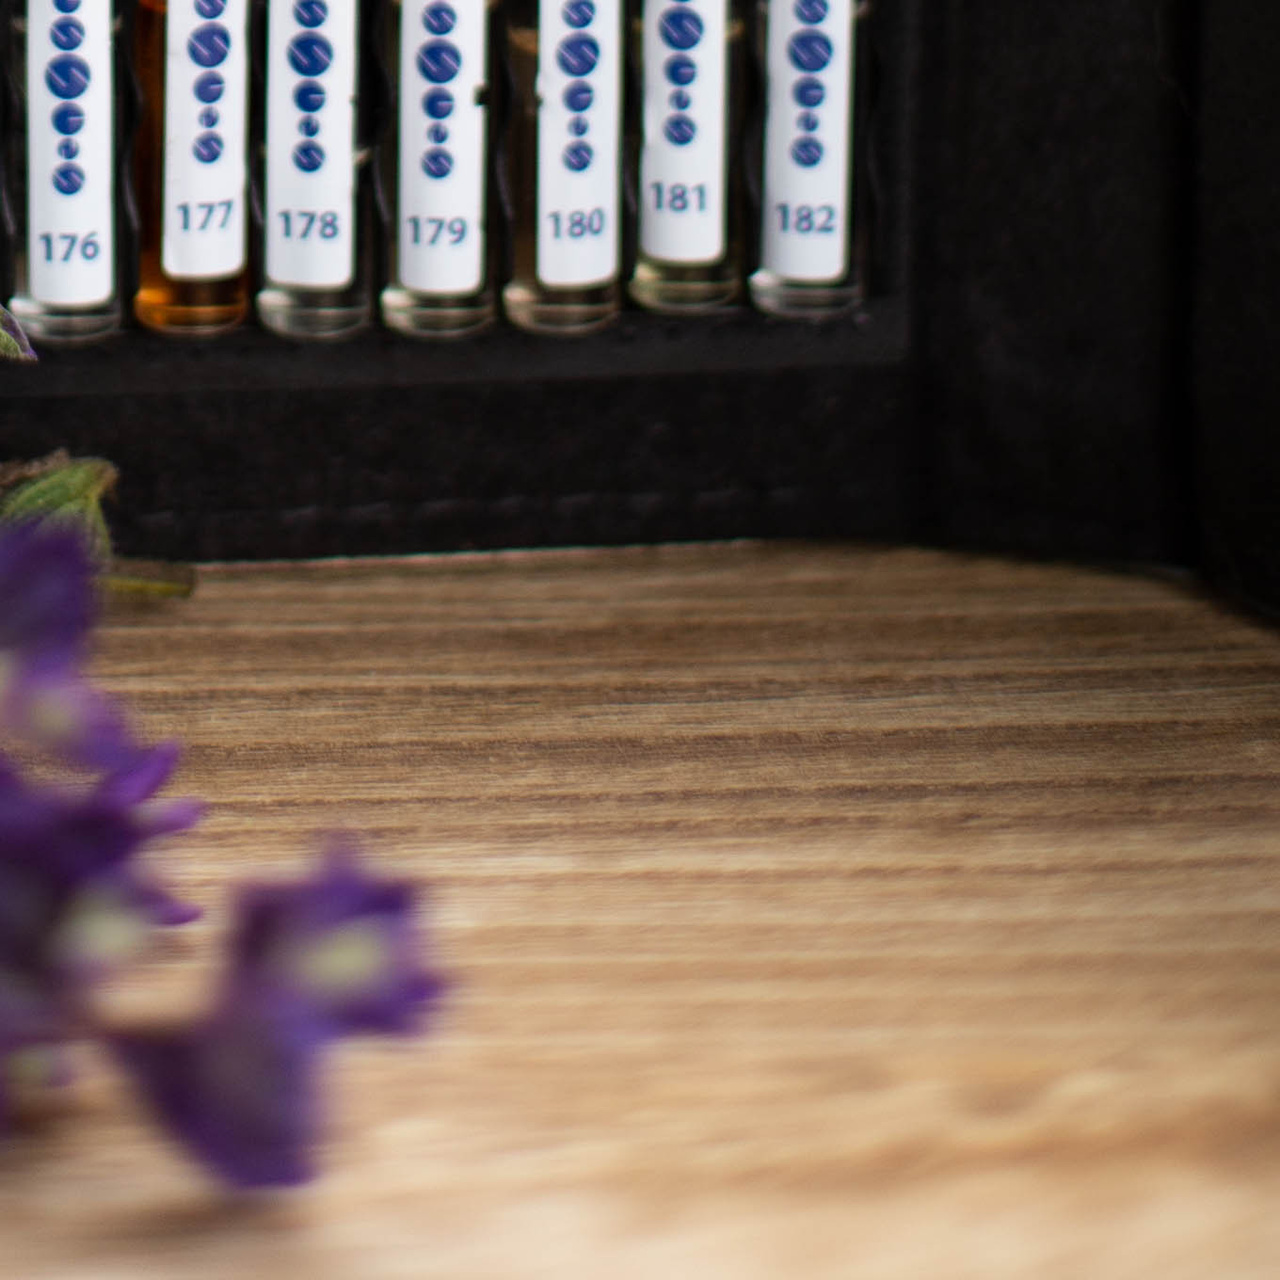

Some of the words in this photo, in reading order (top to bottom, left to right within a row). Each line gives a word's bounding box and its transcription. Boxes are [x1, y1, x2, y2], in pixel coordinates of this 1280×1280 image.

[650, 181, 706, 214] 181
[177, 200, 234, 232] 177
[279, 210, 339, 241] 178
[406, 215, 468, 246] 179
[549, 208, 606, 240] 180
[776, 205, 836, 236] 182
[39, 233, 100, 263] 176
